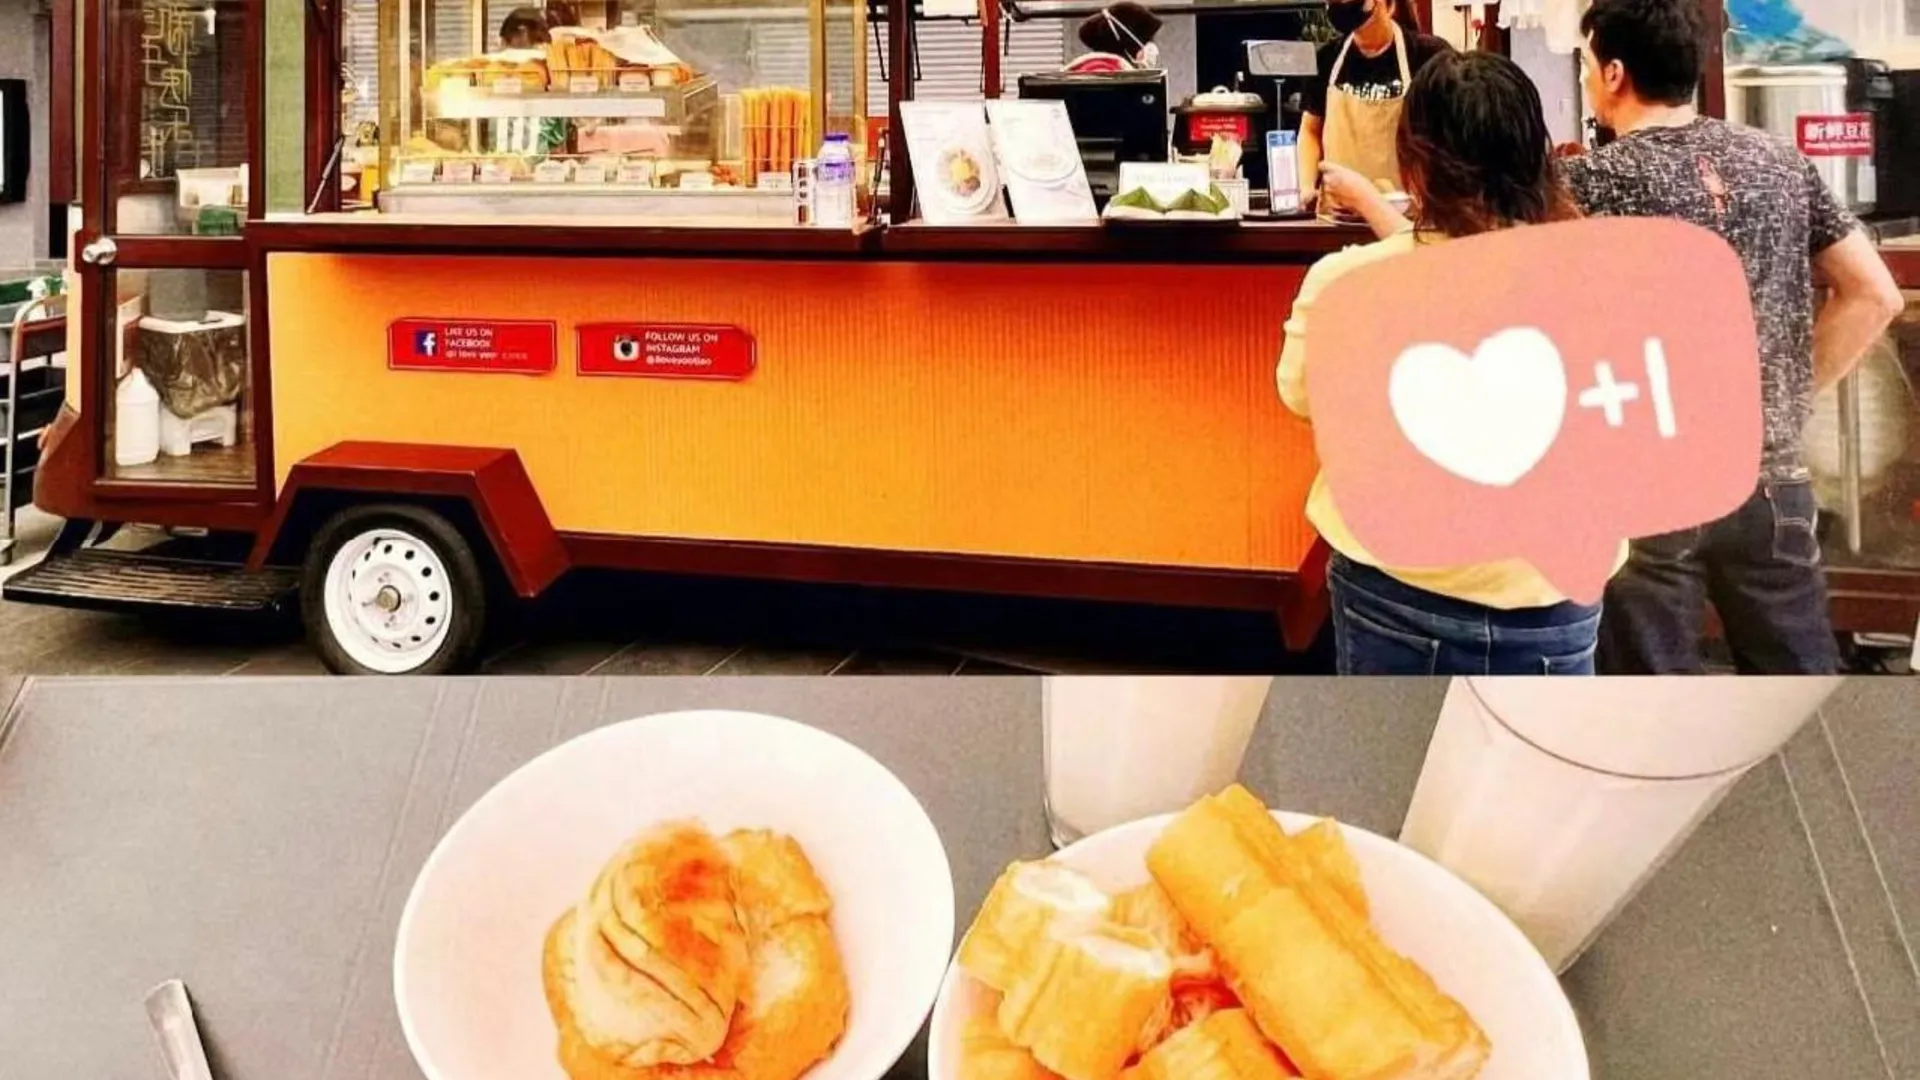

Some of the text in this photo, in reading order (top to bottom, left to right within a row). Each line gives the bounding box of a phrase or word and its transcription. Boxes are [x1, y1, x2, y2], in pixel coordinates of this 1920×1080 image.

[444, 327, 494, 338] LIKE US ON
[645, 331, 719, 343] FOLLOW US ON
[445, 338, 491, 348] FACEBOOK
[646, 343, 701, 354] INSTAGRAM
